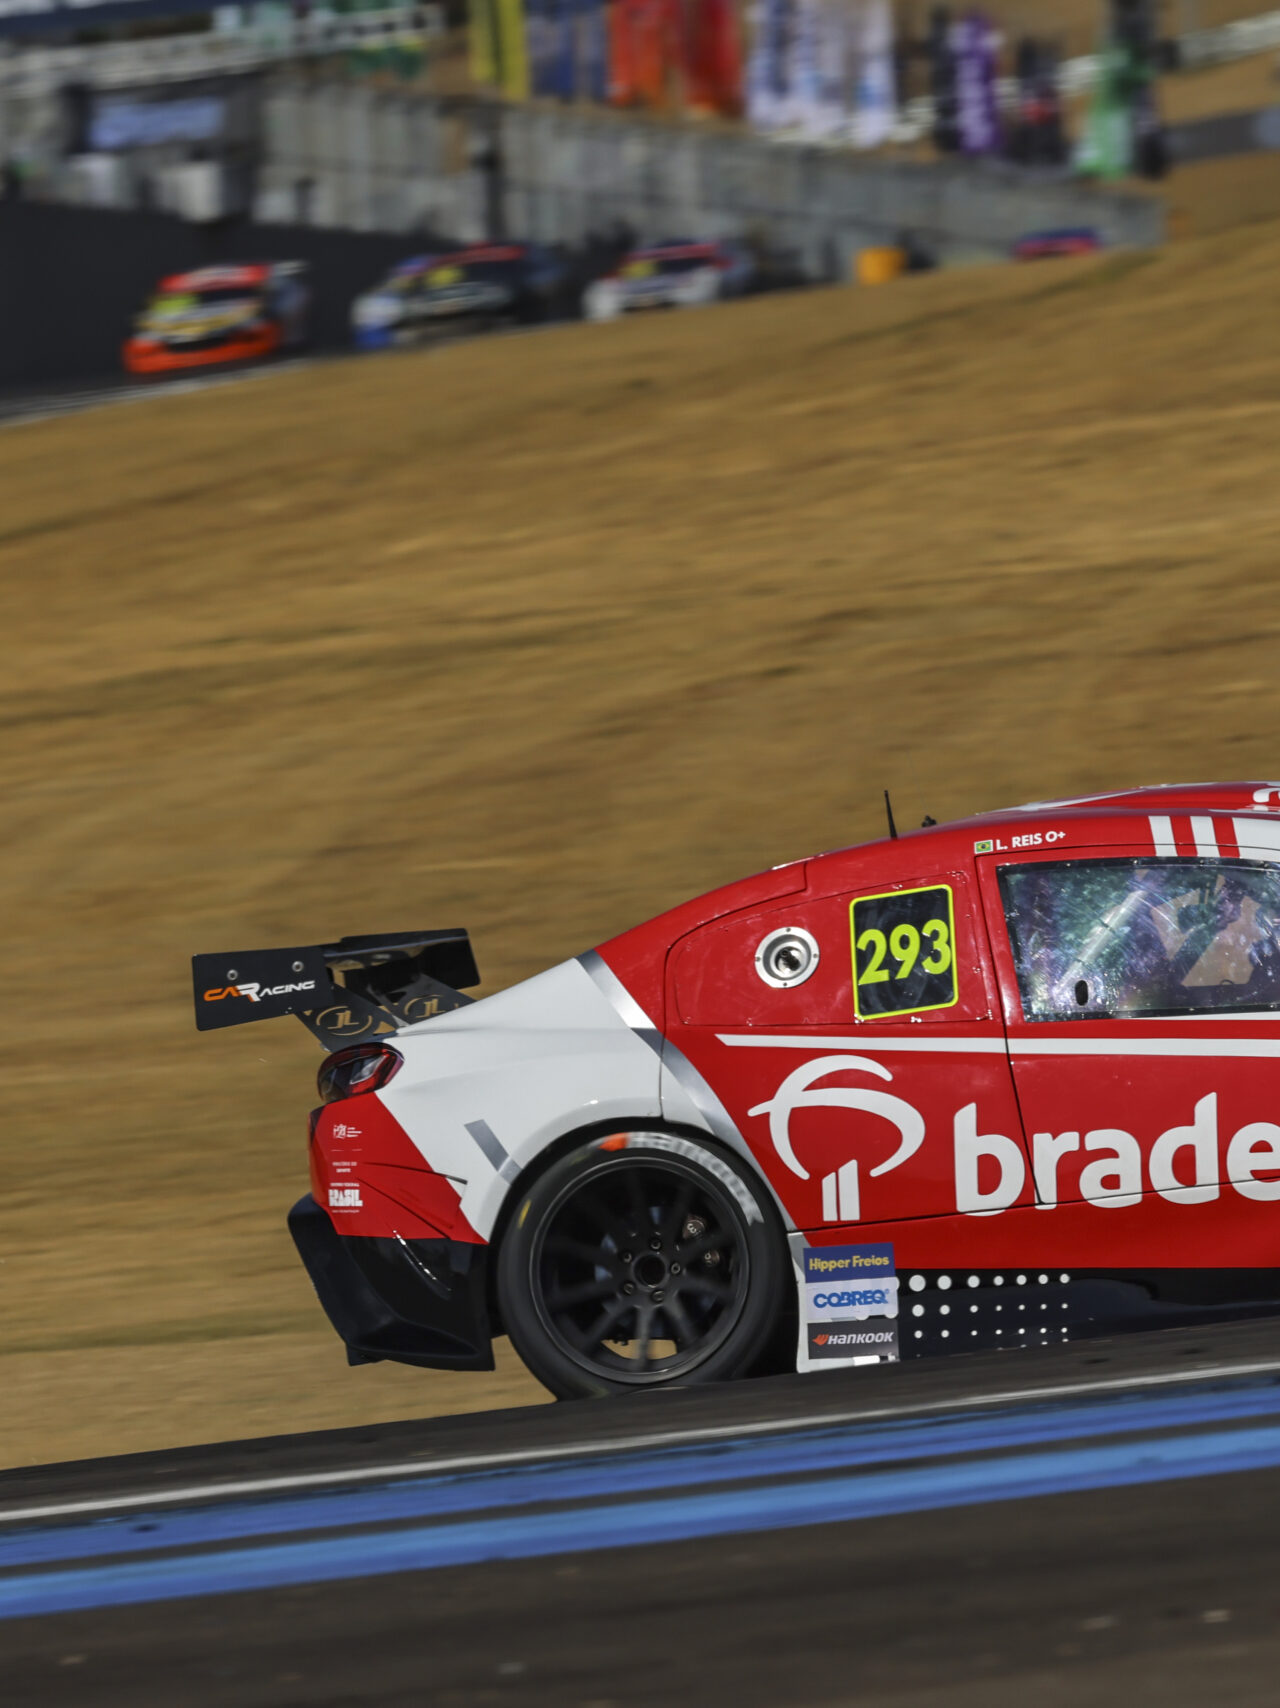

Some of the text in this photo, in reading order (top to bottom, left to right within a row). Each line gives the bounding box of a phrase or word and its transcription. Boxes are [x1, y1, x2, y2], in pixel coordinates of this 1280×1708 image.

[996, 838, 1008, 851] L.
[1011, 833, 1042, 848] REIS
[856, 918, 951, 985] 293
[808, 1254, 890, 1272] Hipper Freios
[812, 1289, 888, 1309] COBREQ
